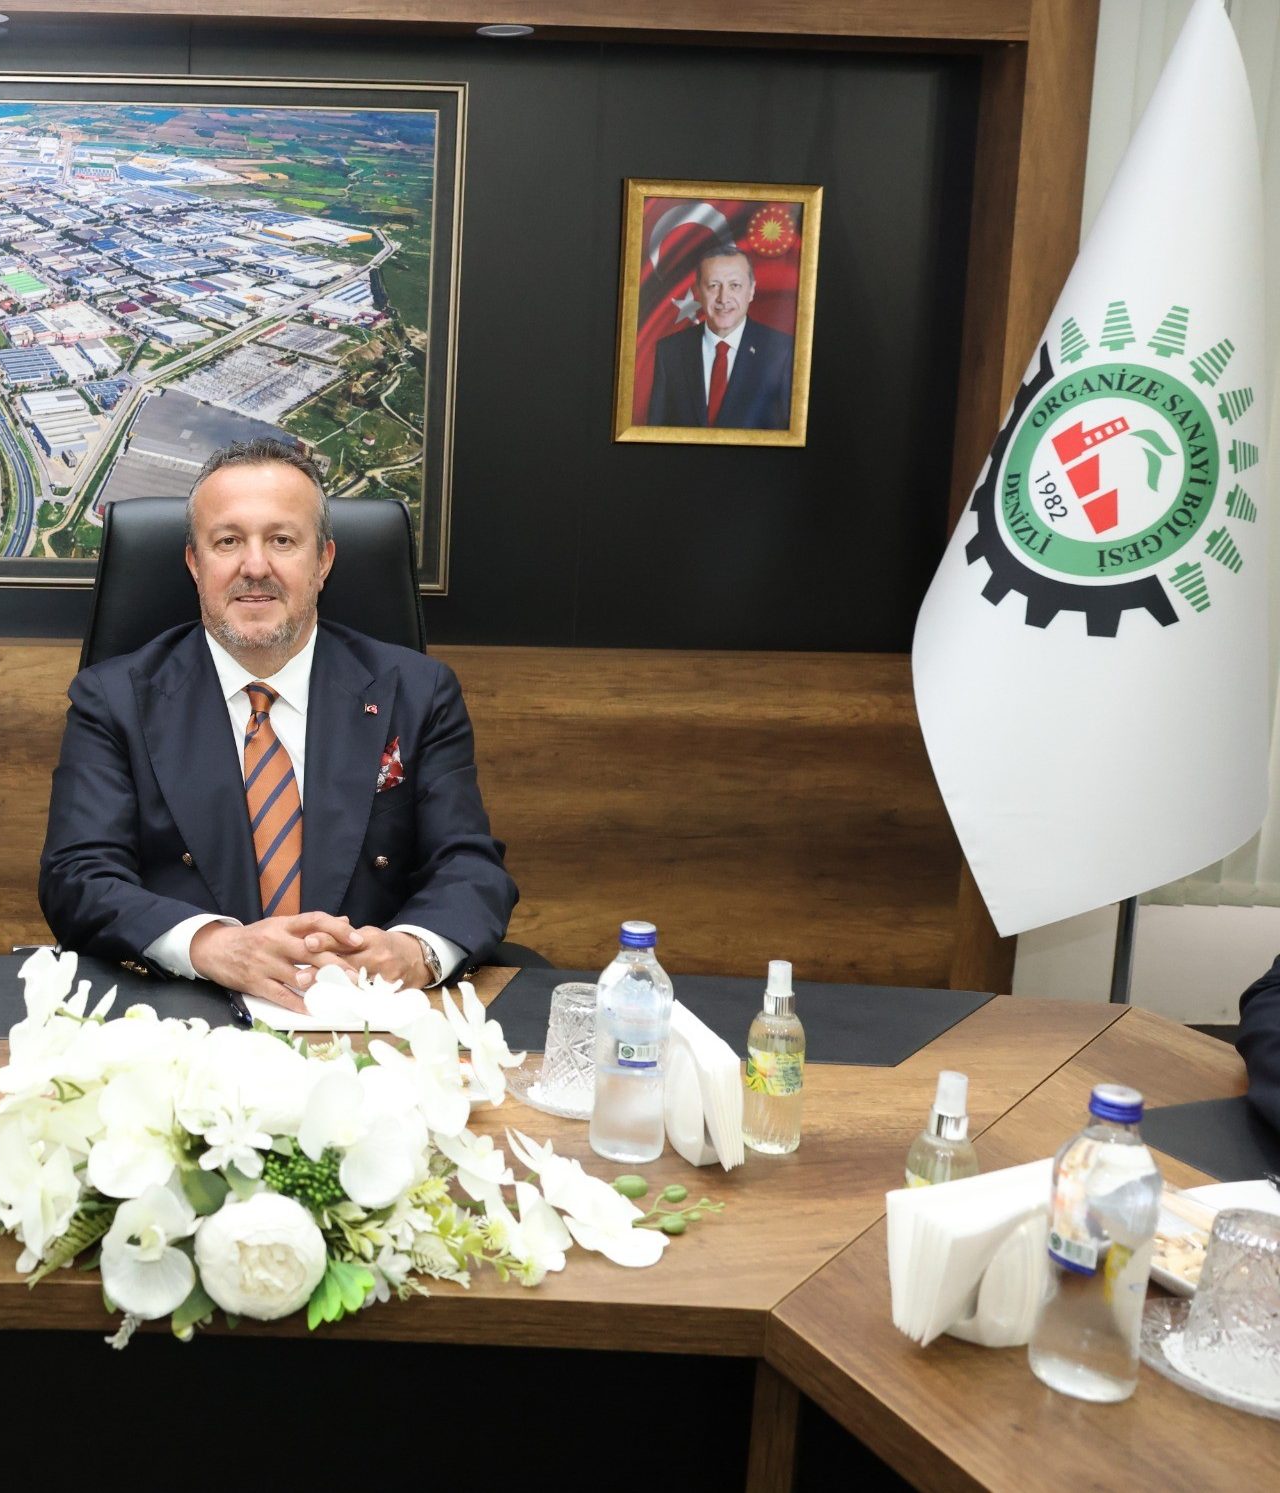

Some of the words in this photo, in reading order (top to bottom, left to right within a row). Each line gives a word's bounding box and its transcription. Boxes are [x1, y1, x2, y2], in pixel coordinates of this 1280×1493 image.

[1032, 368, 1164, 429] ORGANİZE
[1162, 394, 1213, 486] SANAYİ
[1004, 472, 1053, 555] DENİZLİ
[1035, 470, 1068, 522] 1982
[1097, 491, 1203, 573] BÖLGESİ
